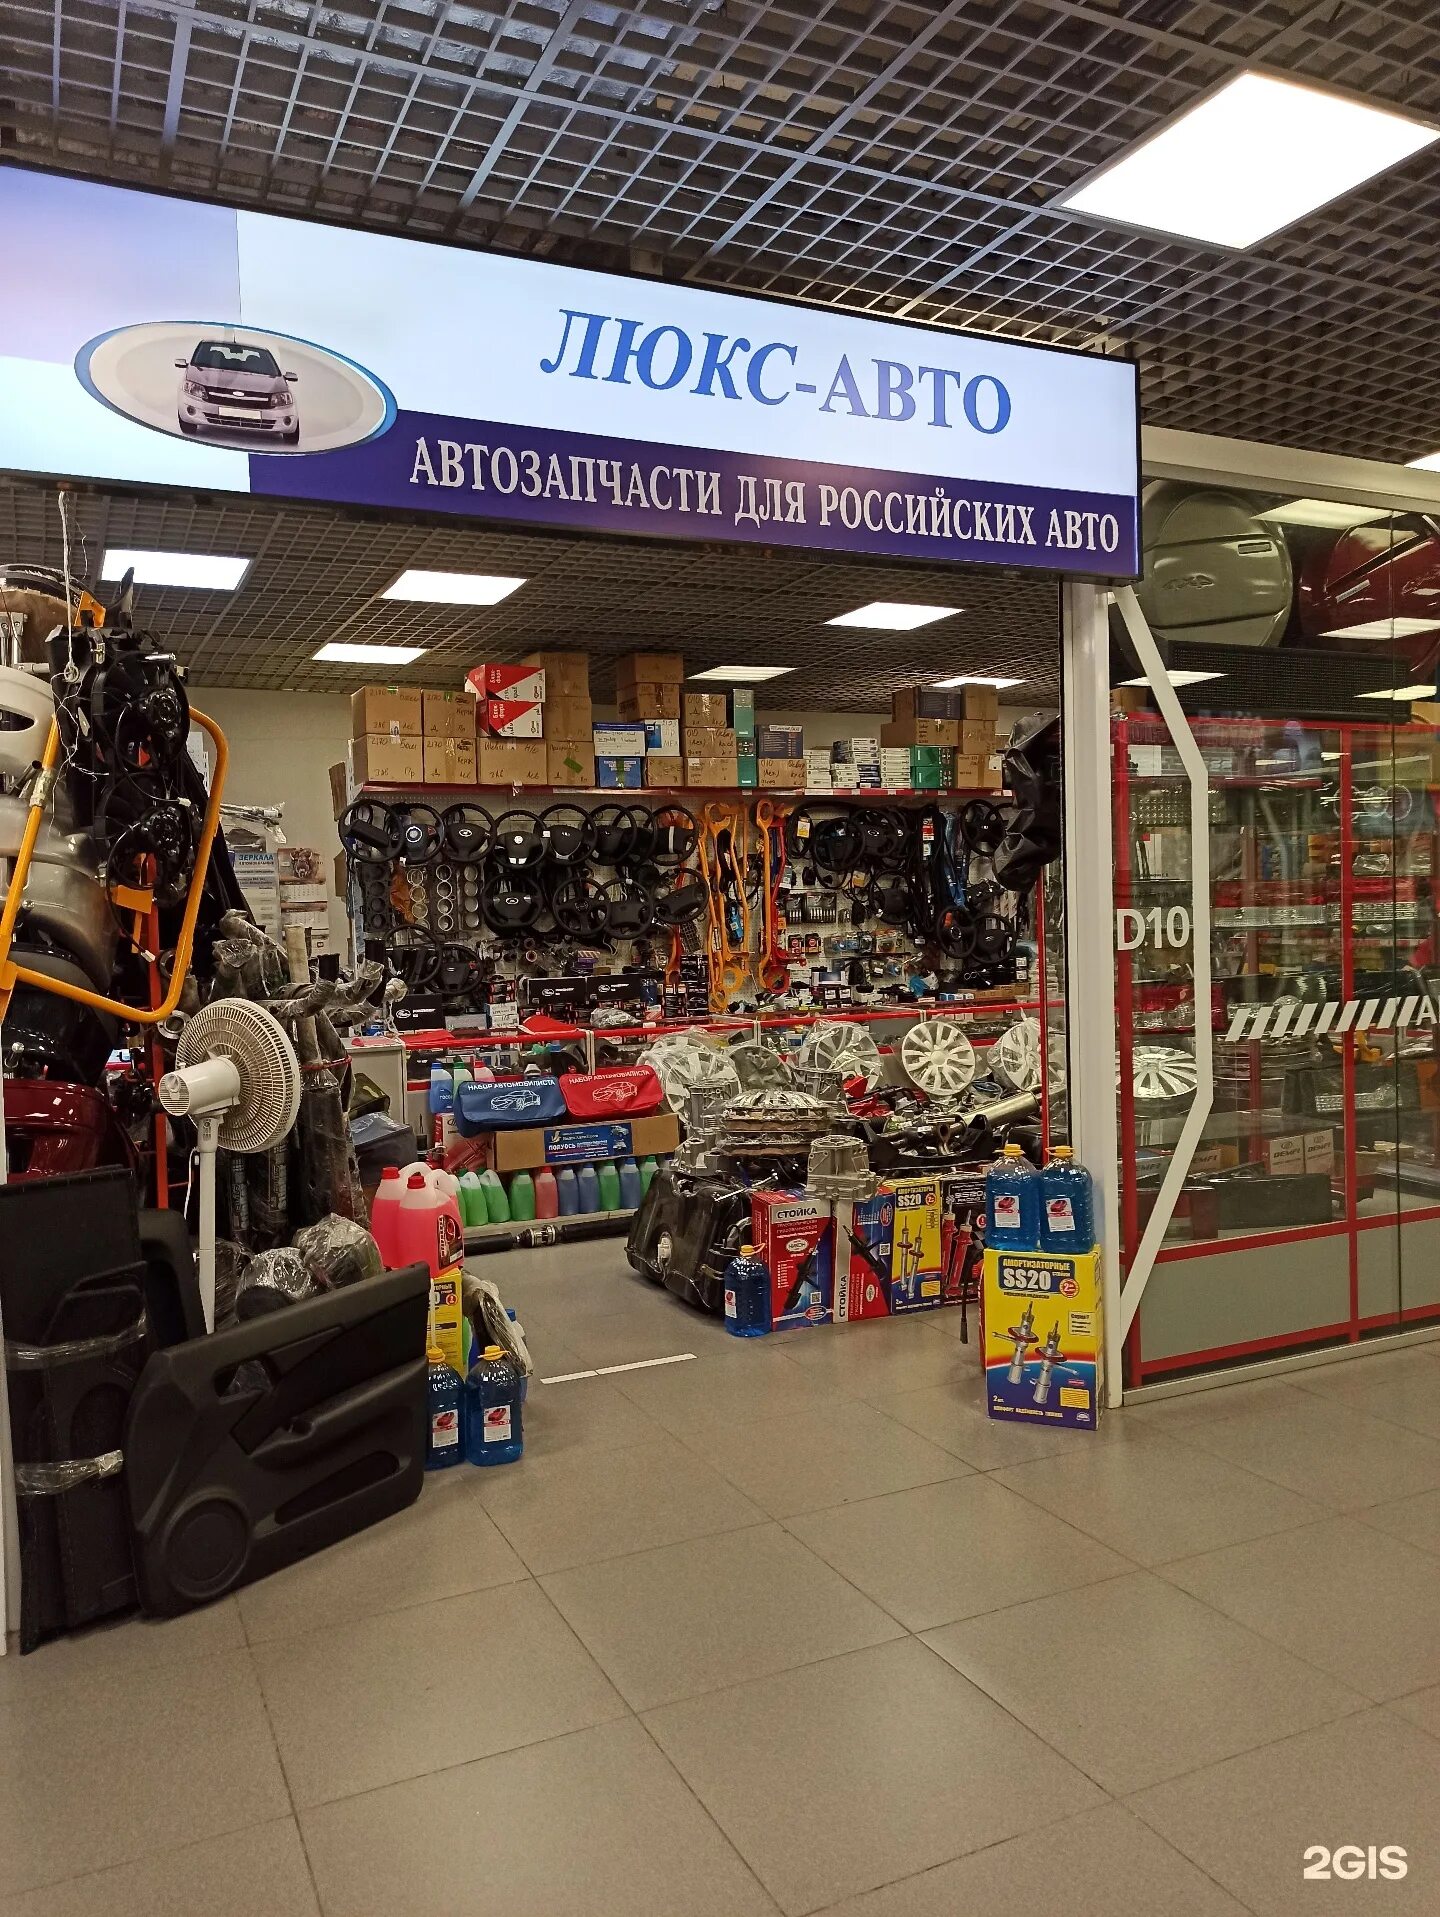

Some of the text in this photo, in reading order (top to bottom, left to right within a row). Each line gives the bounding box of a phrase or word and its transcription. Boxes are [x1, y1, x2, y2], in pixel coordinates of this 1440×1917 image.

[540, 308, 1012, 435] ЛЮКС-АВТО
[409, 437, 1119, 553] АВТОЗАПЧАСТИ ДЛЯ РОССИЙСКИХ АВТО
[1116, 905, 1190, 951] D10
[467, 1079, 556, 1091] НАБОР АВТОМОБИЛИСТА
[898, 1194, 922, 1207] SS20
[777, 1207, 818, 1219] СТОЙКА
[1003, 1258, 1071, 1271] АМОРТИЗАТОРНЫЕ
[1003, 1267, 1051, 1291] SS20
[839, 1275, 847, 1318] СТОЙКА
